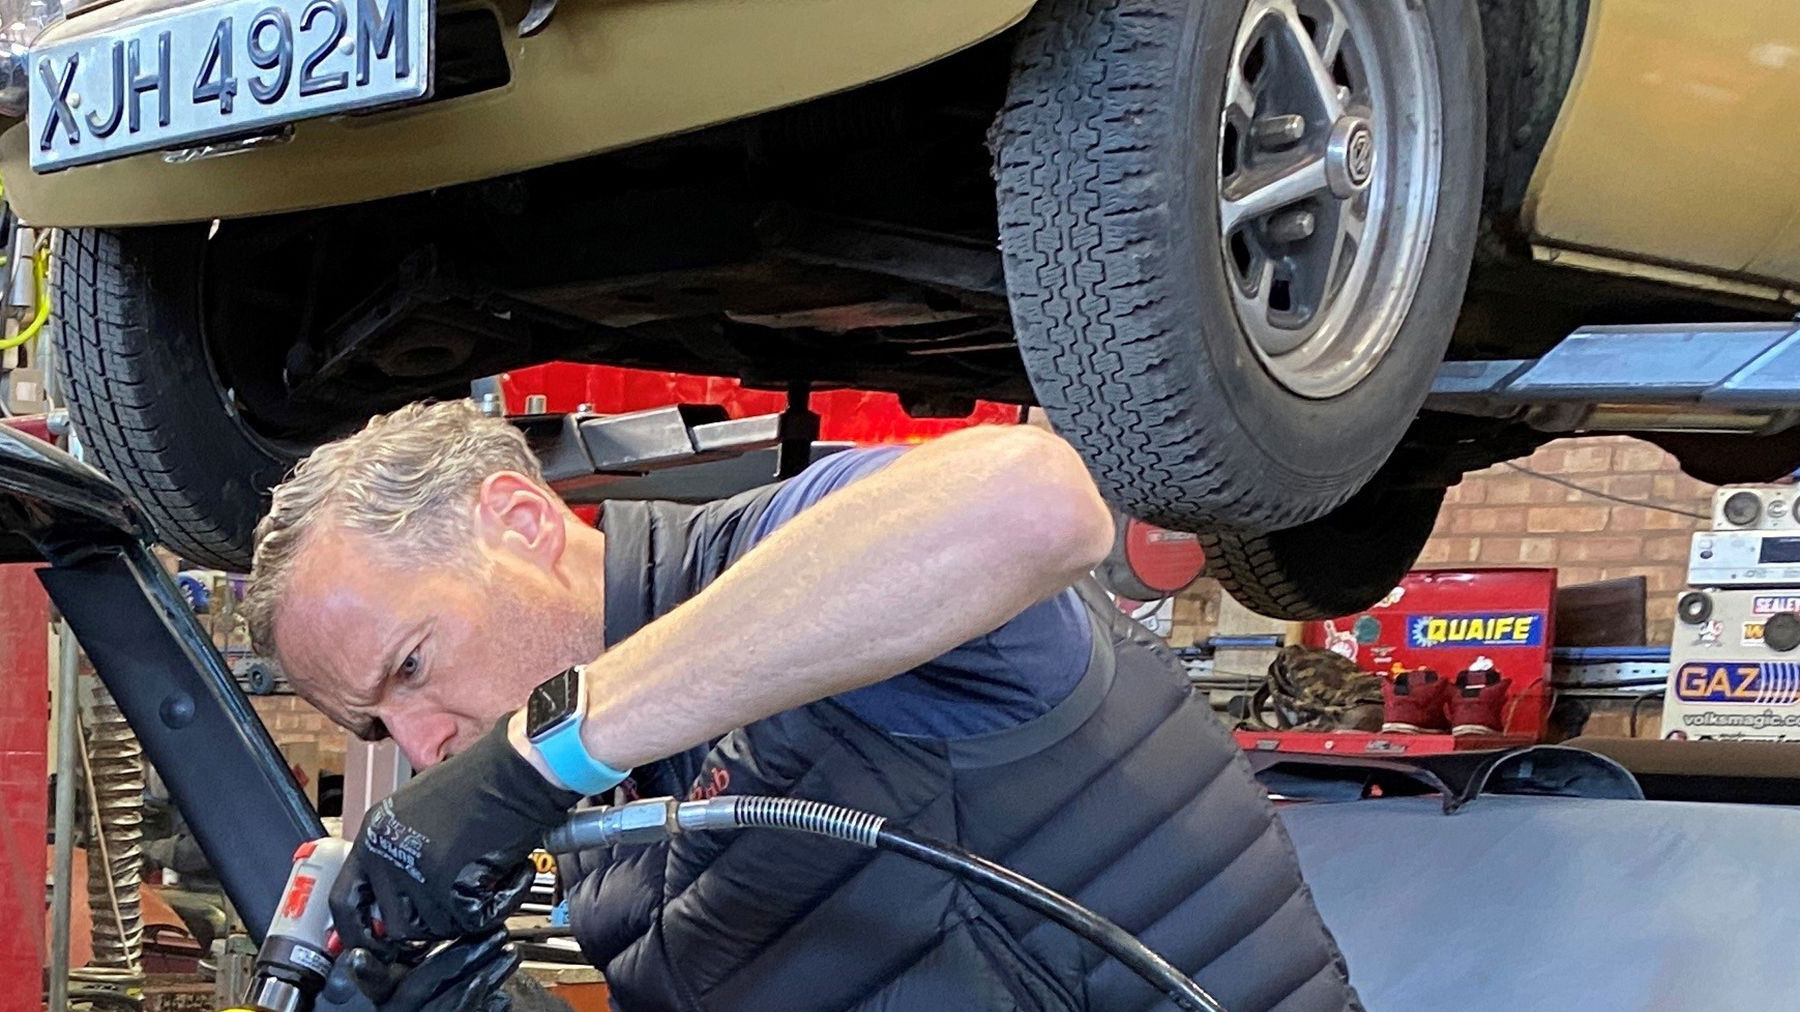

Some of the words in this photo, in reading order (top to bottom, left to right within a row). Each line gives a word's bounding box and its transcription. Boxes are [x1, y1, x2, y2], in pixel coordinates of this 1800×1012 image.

[38, 30, 171, 151] XJH
[192, 0, 410, 115] 492M
[1426, 616, 1534, 643] QUAIFE
[1679, 667, 1762, 698] GAZ
